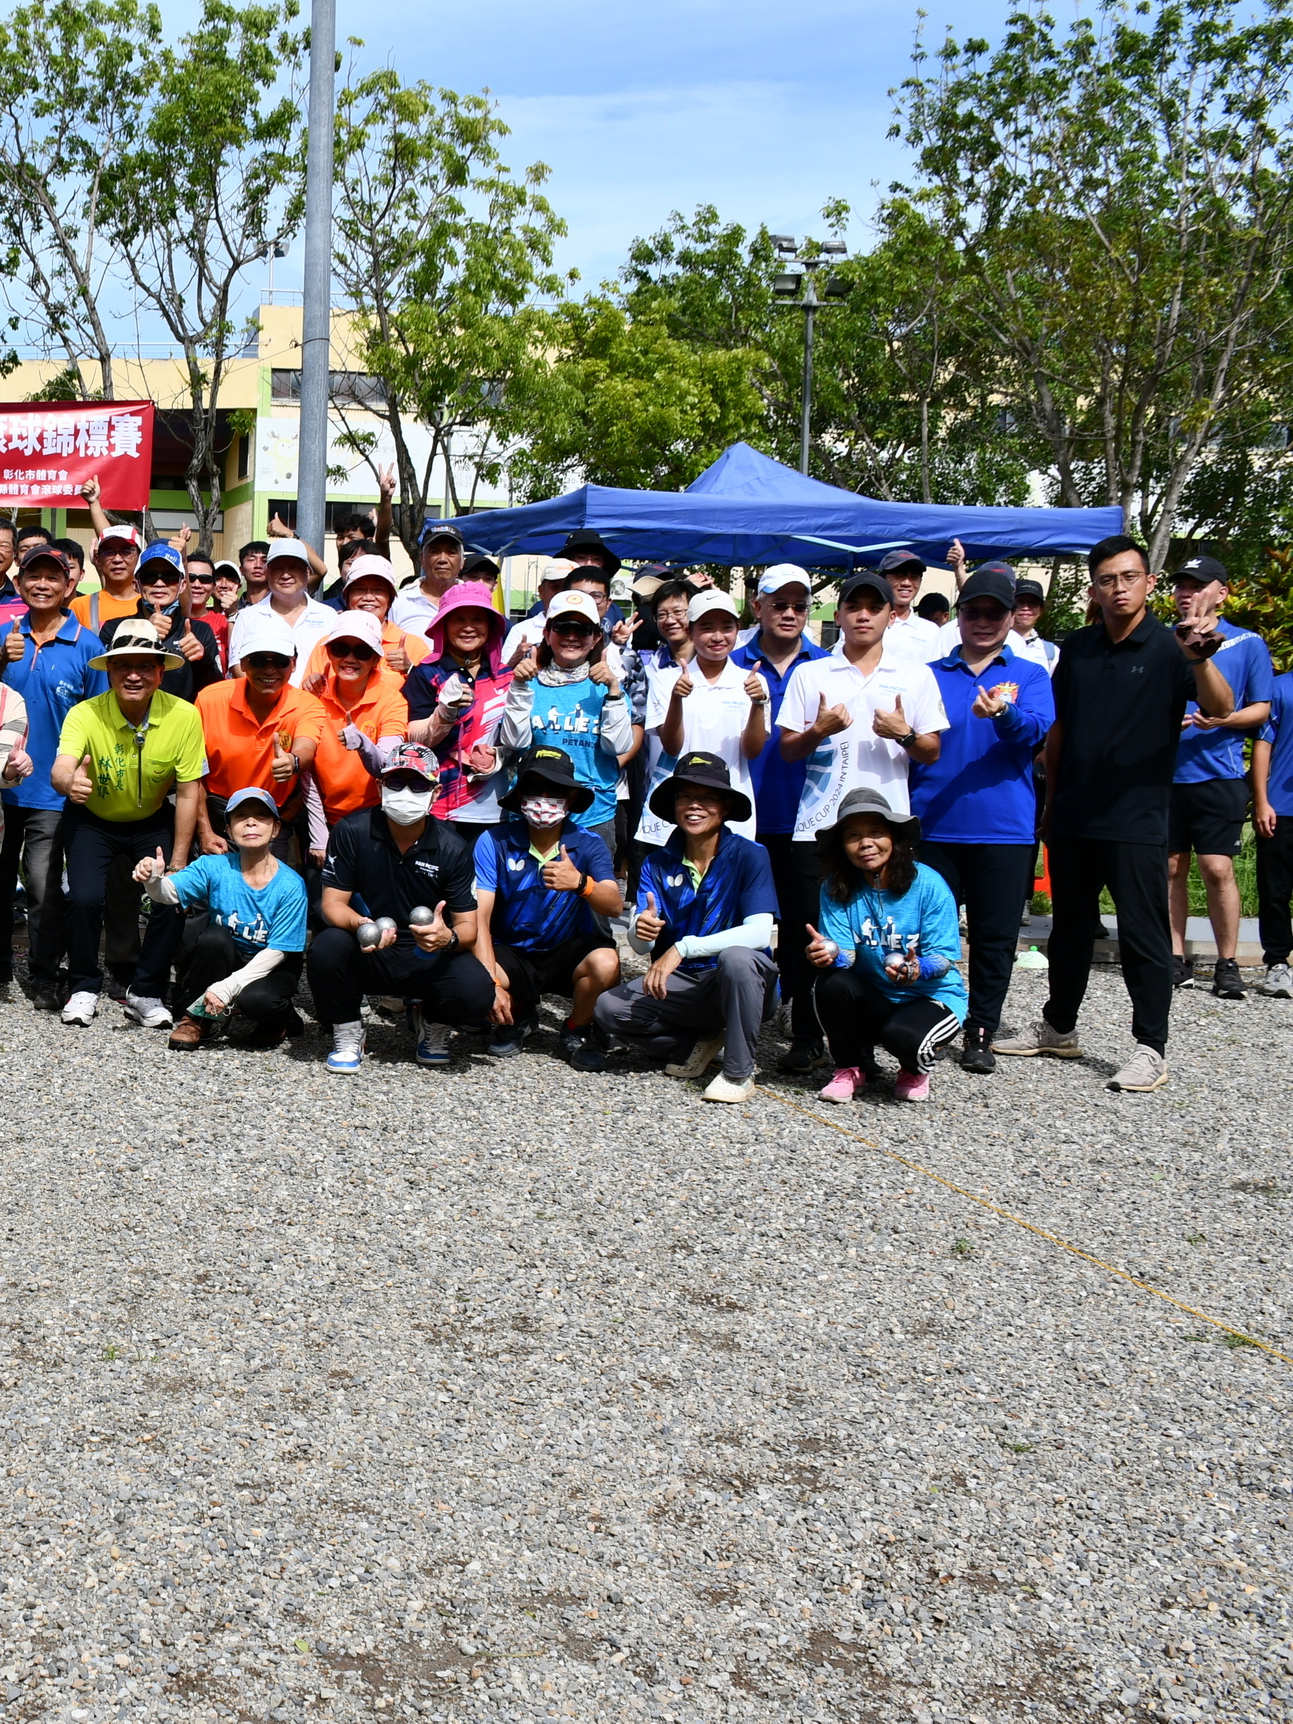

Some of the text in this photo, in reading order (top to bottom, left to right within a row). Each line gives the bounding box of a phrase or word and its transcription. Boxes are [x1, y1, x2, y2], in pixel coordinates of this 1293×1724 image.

[114, 743, 127, 792] 彰化市長
[840, 740, 850, 772] TAIPEI
[96, 756, 114, 800] 林世賢
[840, 772, 848, 784] IN
[831, 783, 845, 808] 2024
[815, 804, 832, 822] CUP
